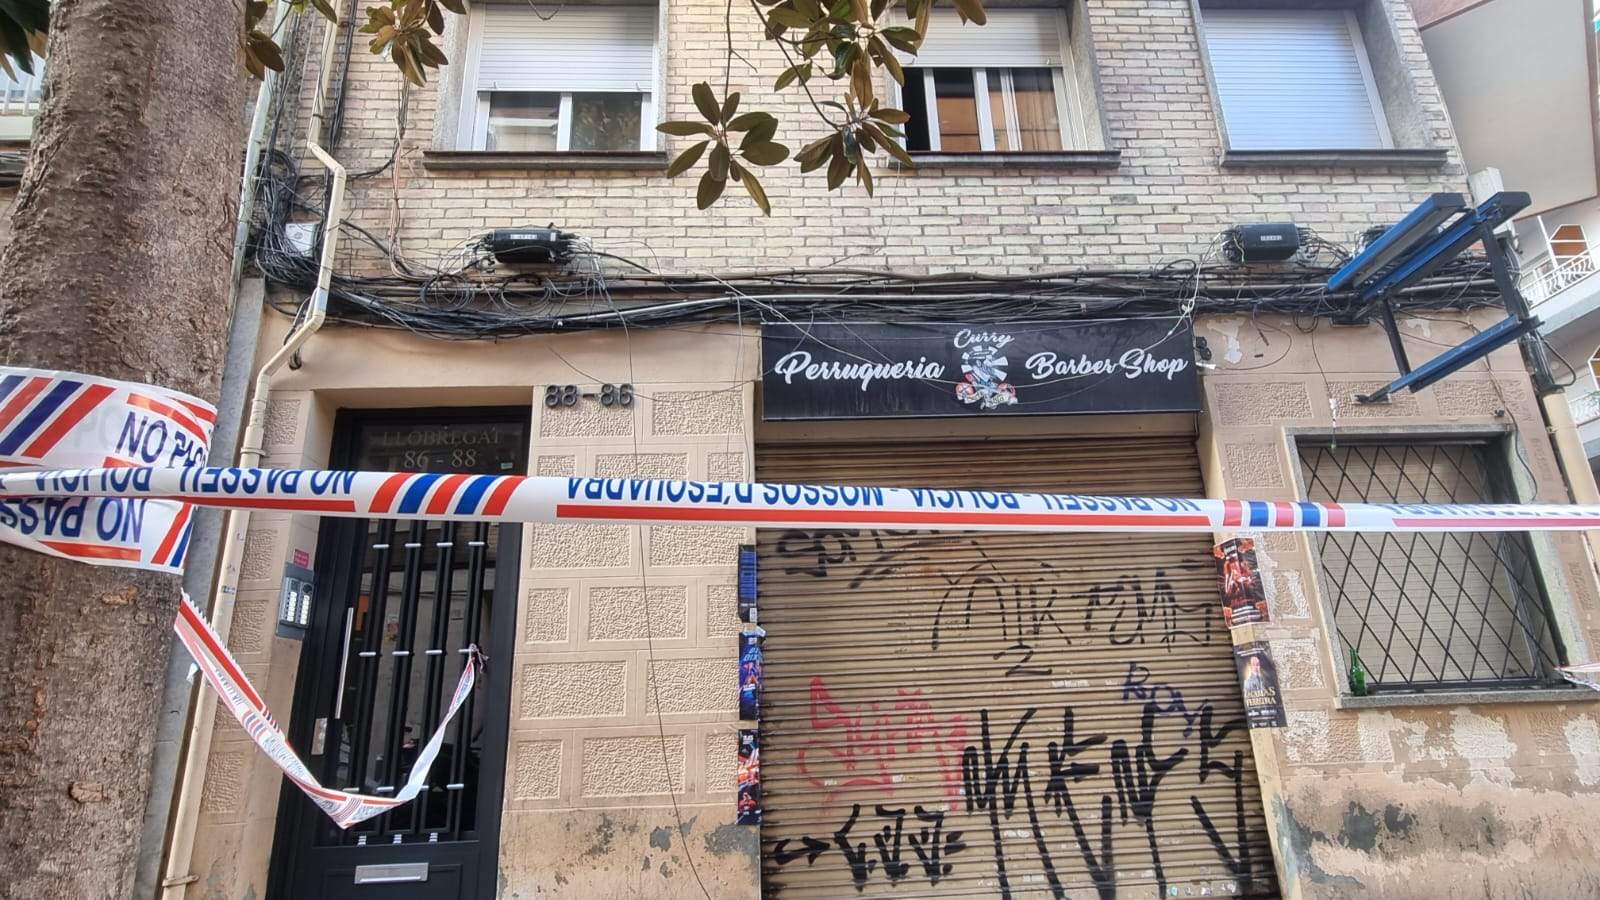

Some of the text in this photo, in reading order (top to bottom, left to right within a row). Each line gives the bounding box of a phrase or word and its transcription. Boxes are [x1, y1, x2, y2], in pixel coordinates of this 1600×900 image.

[953, 328, 1015, 349] Curry
[774, 350, 945, 391] Perruqueria
[1025, 348, 1189, 387] Barber Shop
[115, 410, 168, 463] NO
[383, 429, 500, 446] LLOBREGAT
[403, 449, 429, 469] 86
[451, 448, 478, 468] 88
[311, 470, 358, 496] NO
[96, 496, 146, 543] NO
